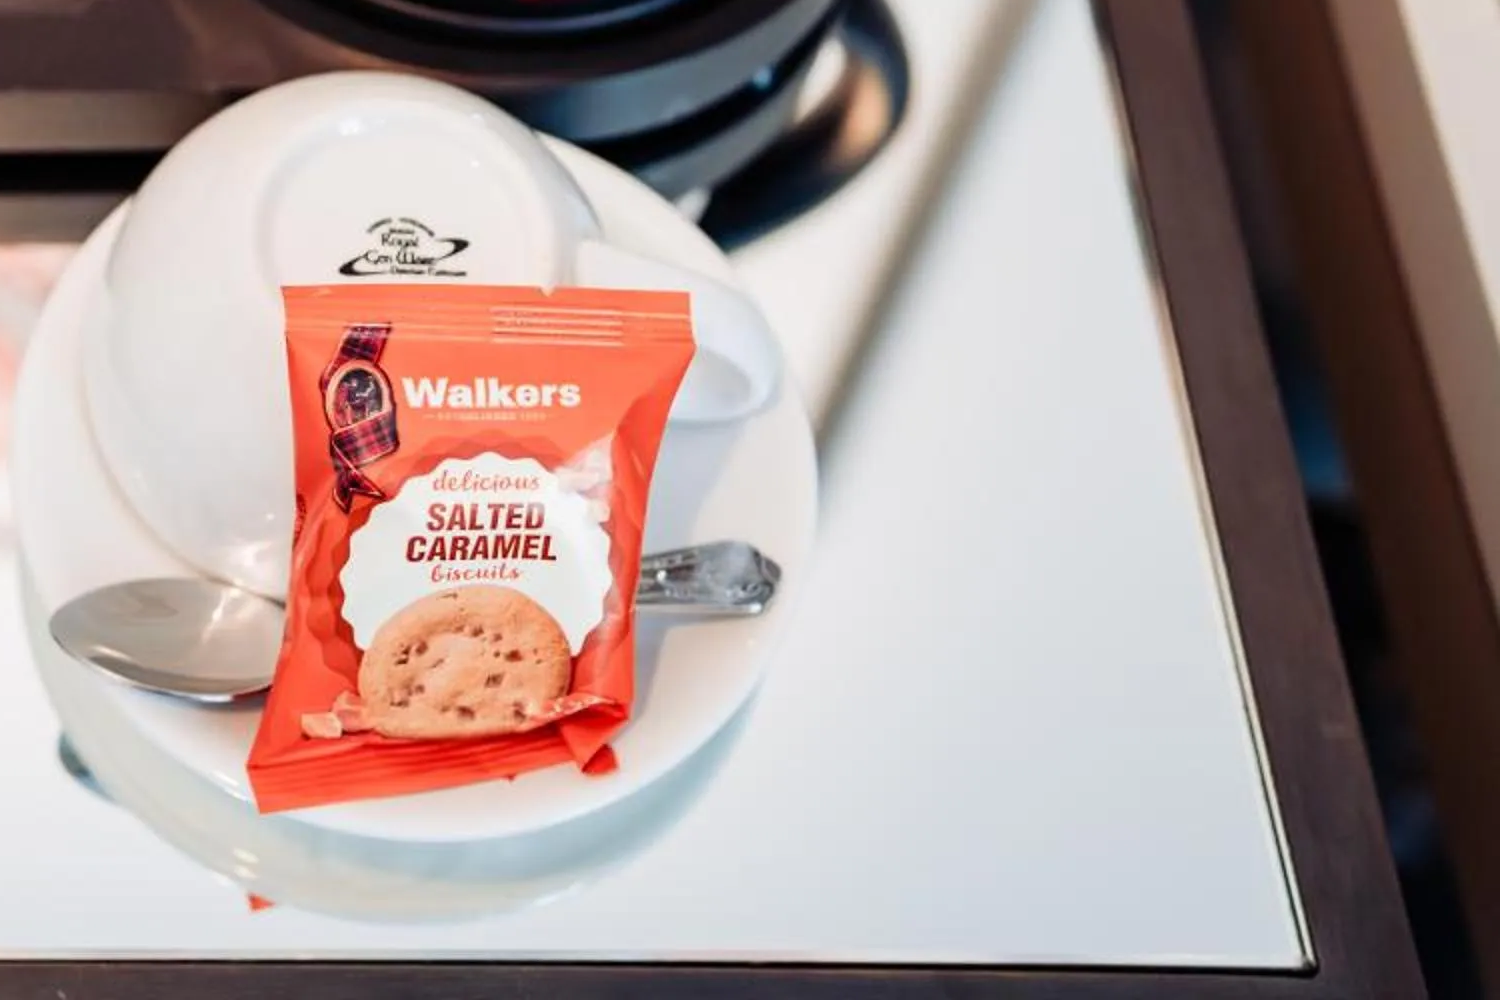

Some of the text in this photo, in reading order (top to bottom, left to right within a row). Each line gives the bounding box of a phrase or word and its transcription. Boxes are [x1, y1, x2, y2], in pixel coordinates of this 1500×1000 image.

[401, 375, 582, 410] Walkers
[432, 469, 541, 493] delicious
[426, 502, 546, 532] SALTED
[405, 534, 558, 563] CARAMEL
[430, 563, 524, 583] biscuits
